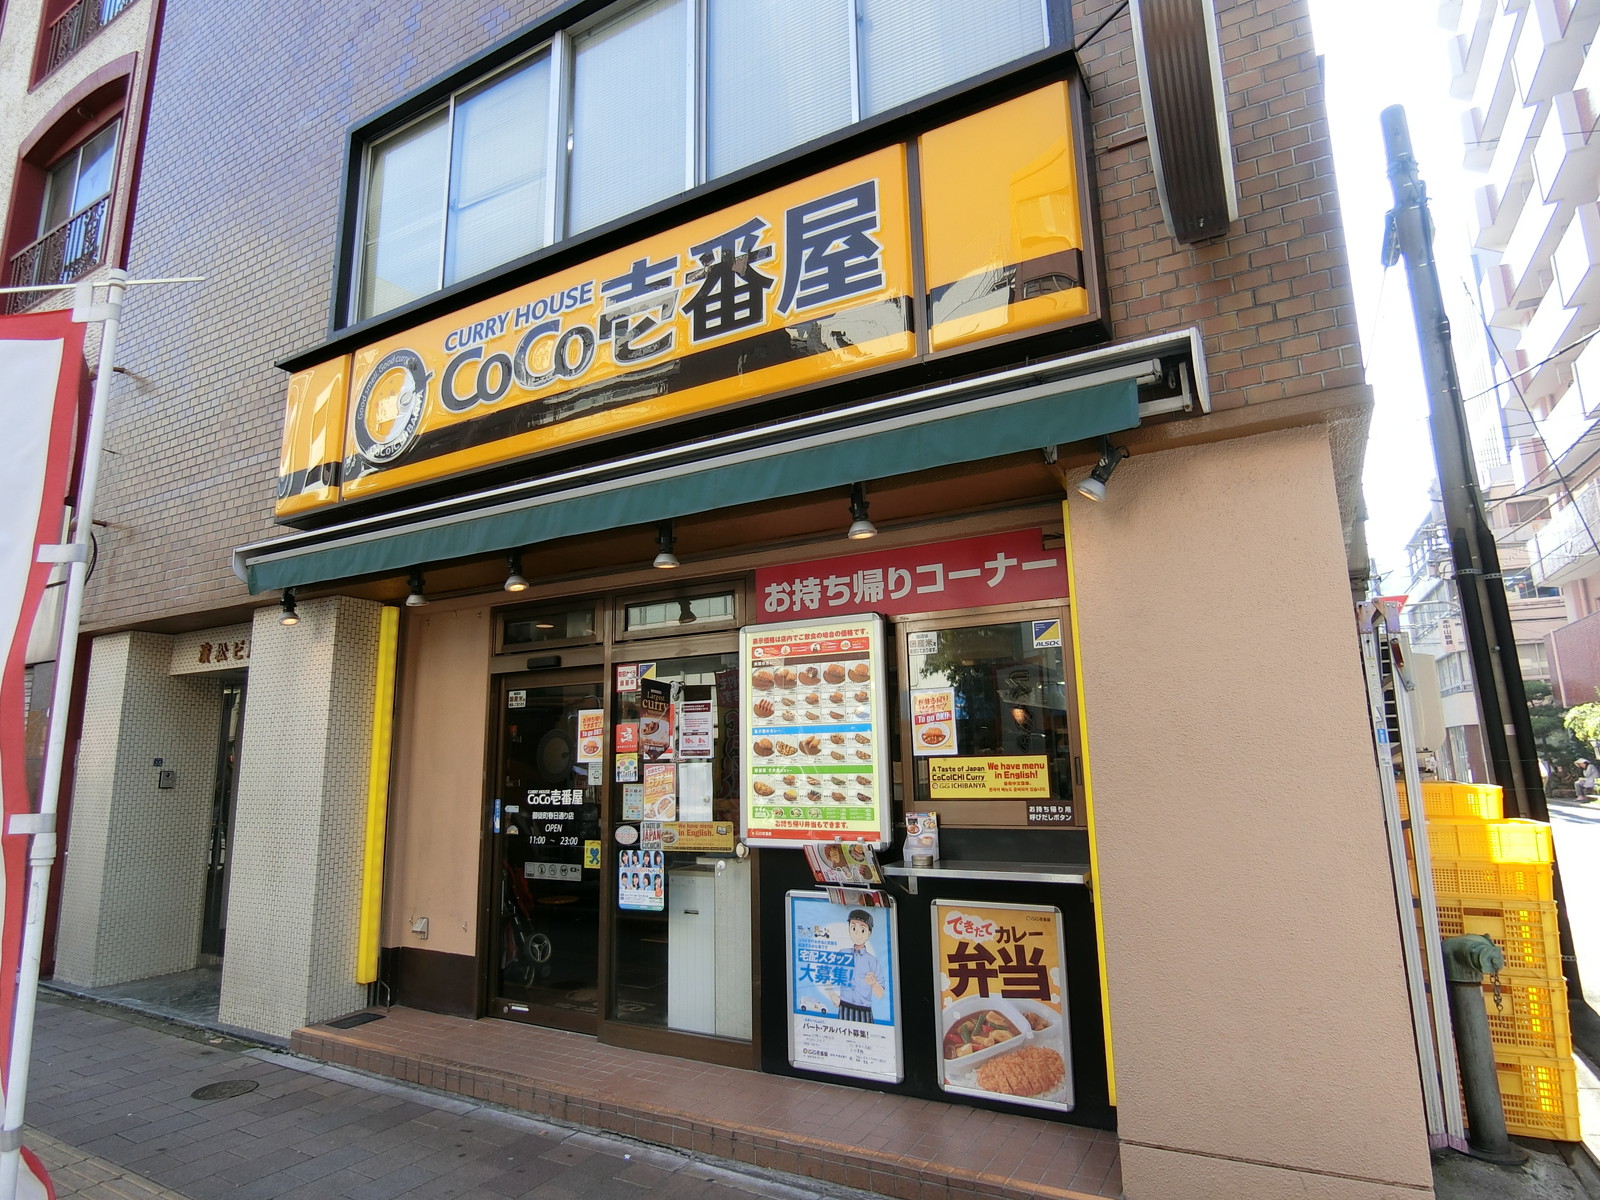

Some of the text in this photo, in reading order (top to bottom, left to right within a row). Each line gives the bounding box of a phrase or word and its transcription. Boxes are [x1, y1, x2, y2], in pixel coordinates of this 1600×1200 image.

[445, 281, 594, 352] CURRY HOUSE
[764, 552, 1058, 613] お持ち帰りコーナー
[642, 698, 668, 712] curry
[995, 771, 1038, 780] in English!
[545, 824, 563, 832] OPEN
[642, 829, 661, 841] JAPAN
[687, 829, 714, 837] English.
[529, 836, 546, 845] 11:00
[560, 836, 579, 846] 23:00
[946, 916, 1043, 944] できたて カレー
[799, 950, 853, 964] 宅配スタッフ
[799, 964, 854, 987] 大募集!
[947, 941, 1051, 1001] 弁当
